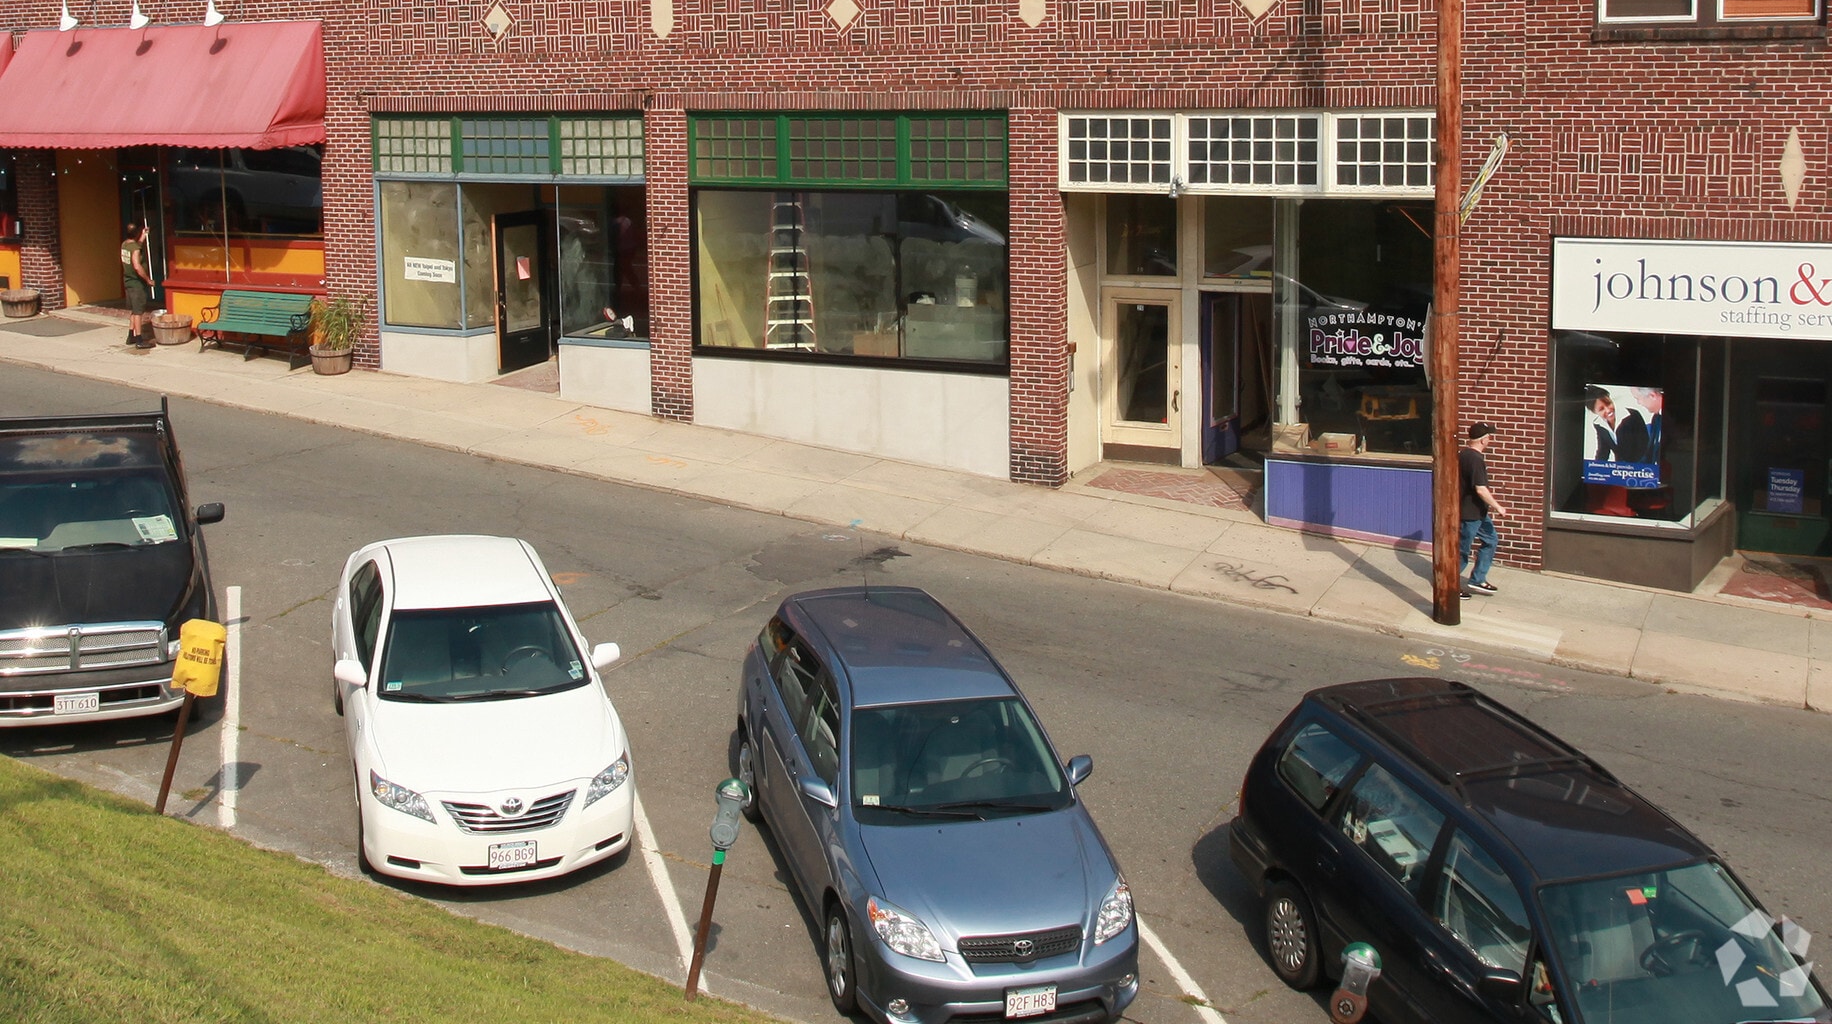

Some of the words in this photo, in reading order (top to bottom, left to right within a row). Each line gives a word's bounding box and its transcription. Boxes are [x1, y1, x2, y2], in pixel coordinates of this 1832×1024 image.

[1592, 258, 1781, 313] johnson
[1720, 306, 1793, 331] staffing
[1611, 469, 1655, 480] expertise
[1771, 476, 1798, 486] Tuesday
[1771, 483, 1801, 494] Thursday
[57, 700, 75, 711] 3TT
[78, 698, 97, 708] 610
[491, 851, 511, 864] 966
[514, 847, 534, 861] BG9
[1009, 996, 1030, 1012] 92F
[1033, 992, 1055, 1008] H83
